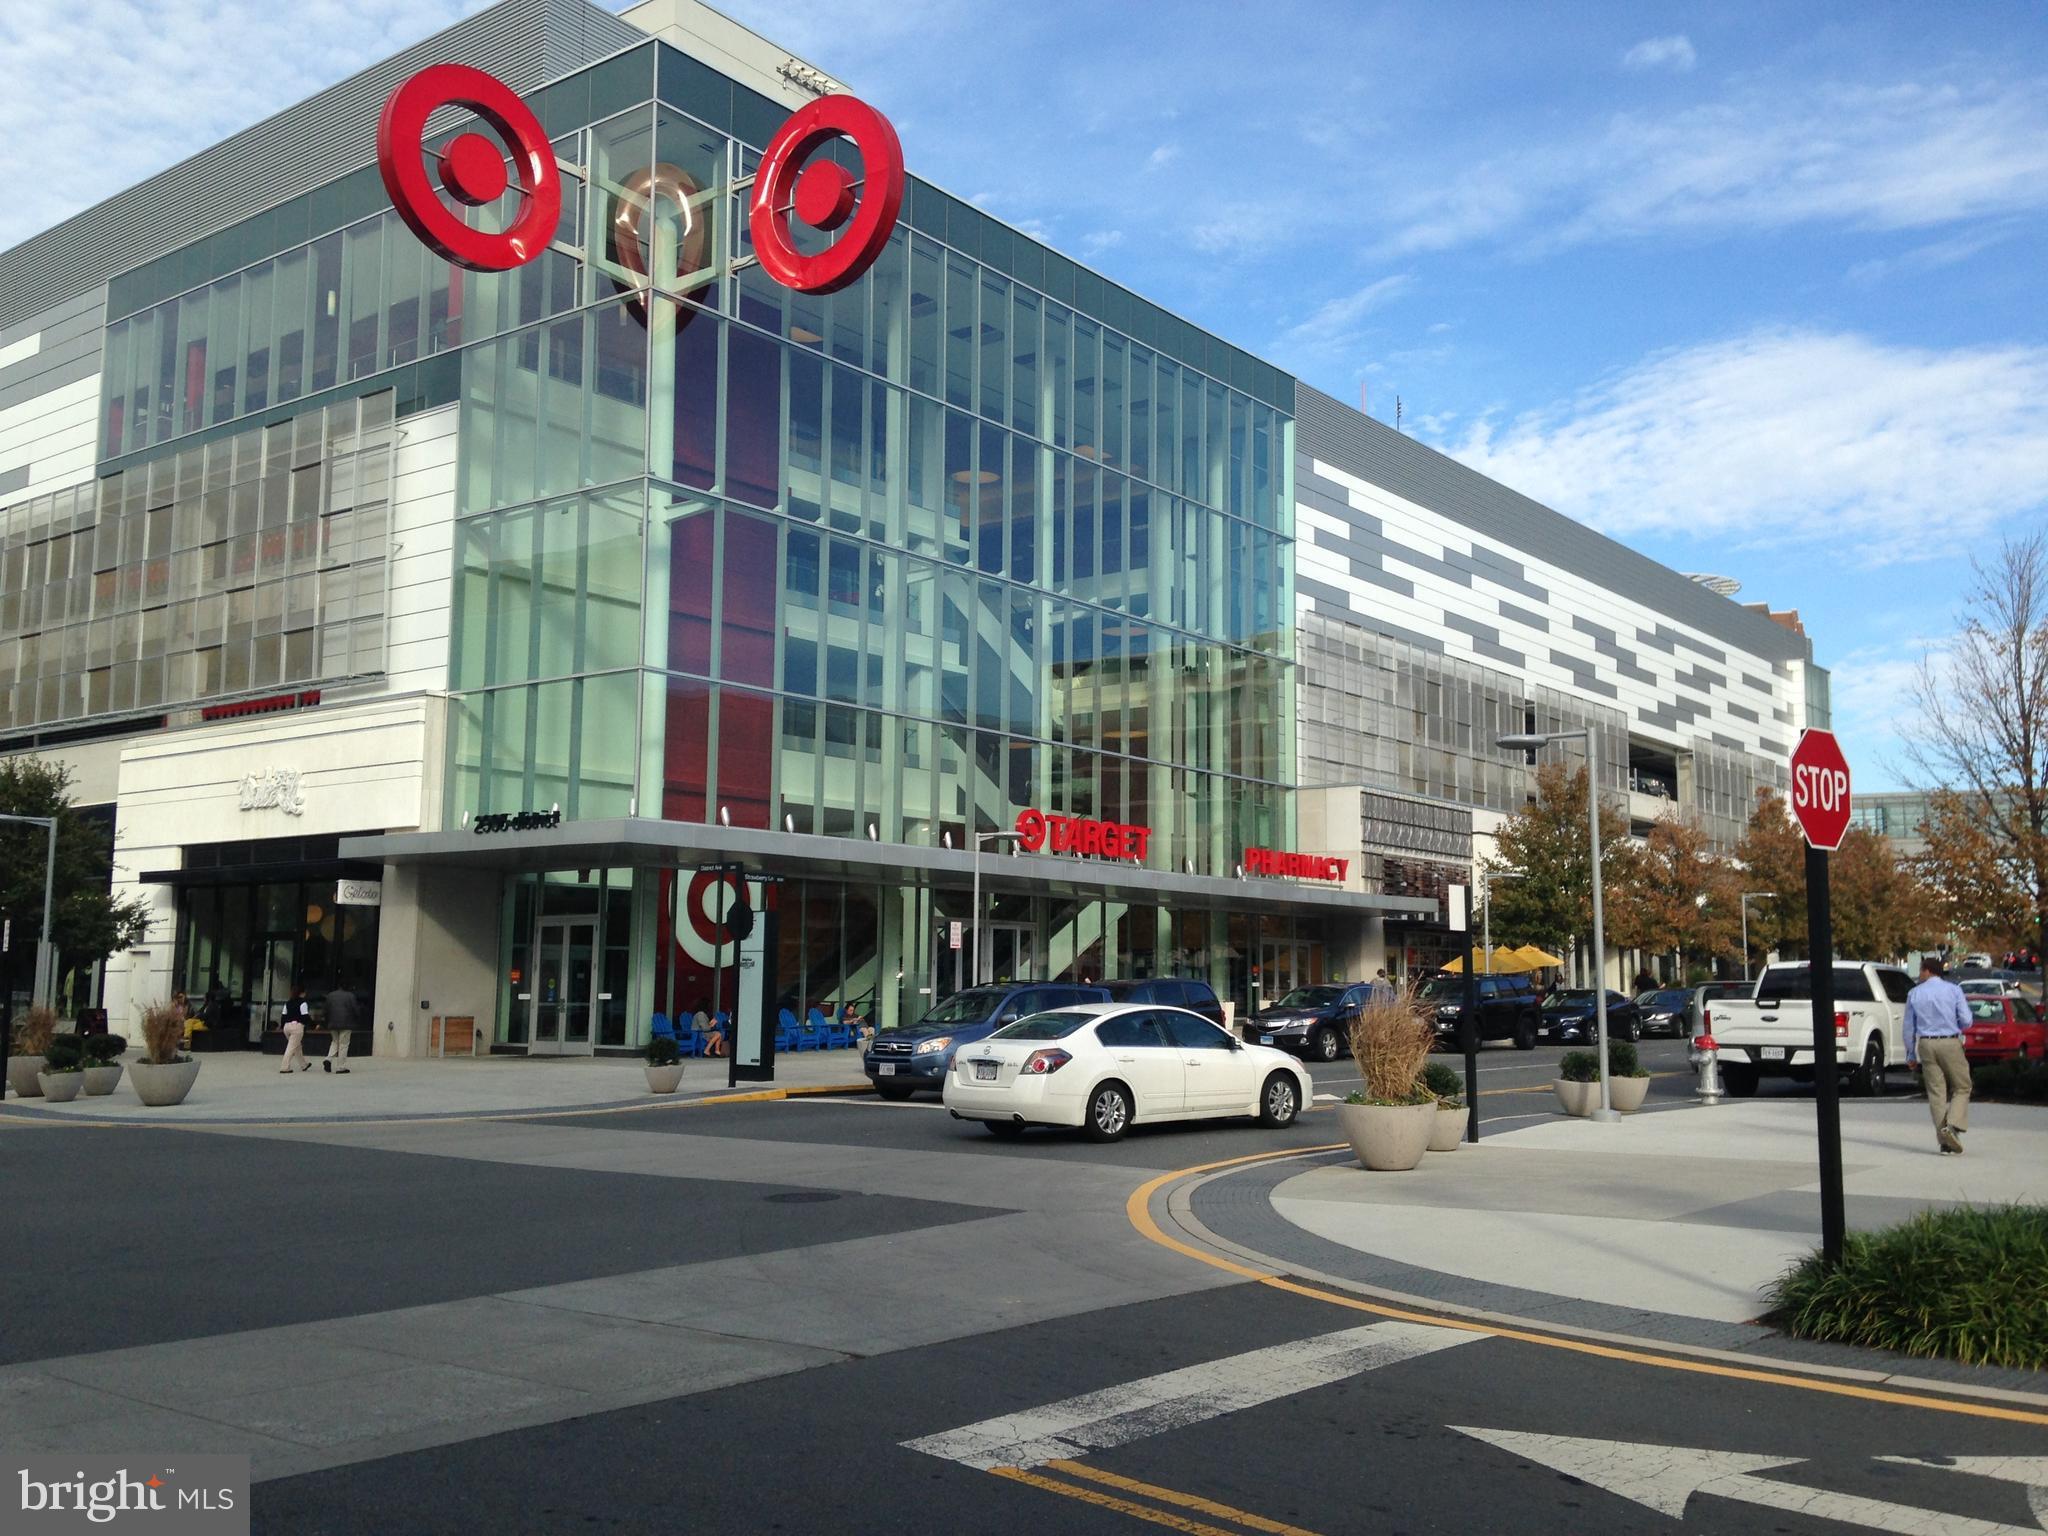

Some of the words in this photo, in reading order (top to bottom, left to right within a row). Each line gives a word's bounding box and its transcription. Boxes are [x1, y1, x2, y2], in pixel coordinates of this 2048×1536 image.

[1796, 763, 1847, 812] STOP
[1045, 814, 1152, 861] TARGET
[1245, 848, 1349, 881] PHARMACY
